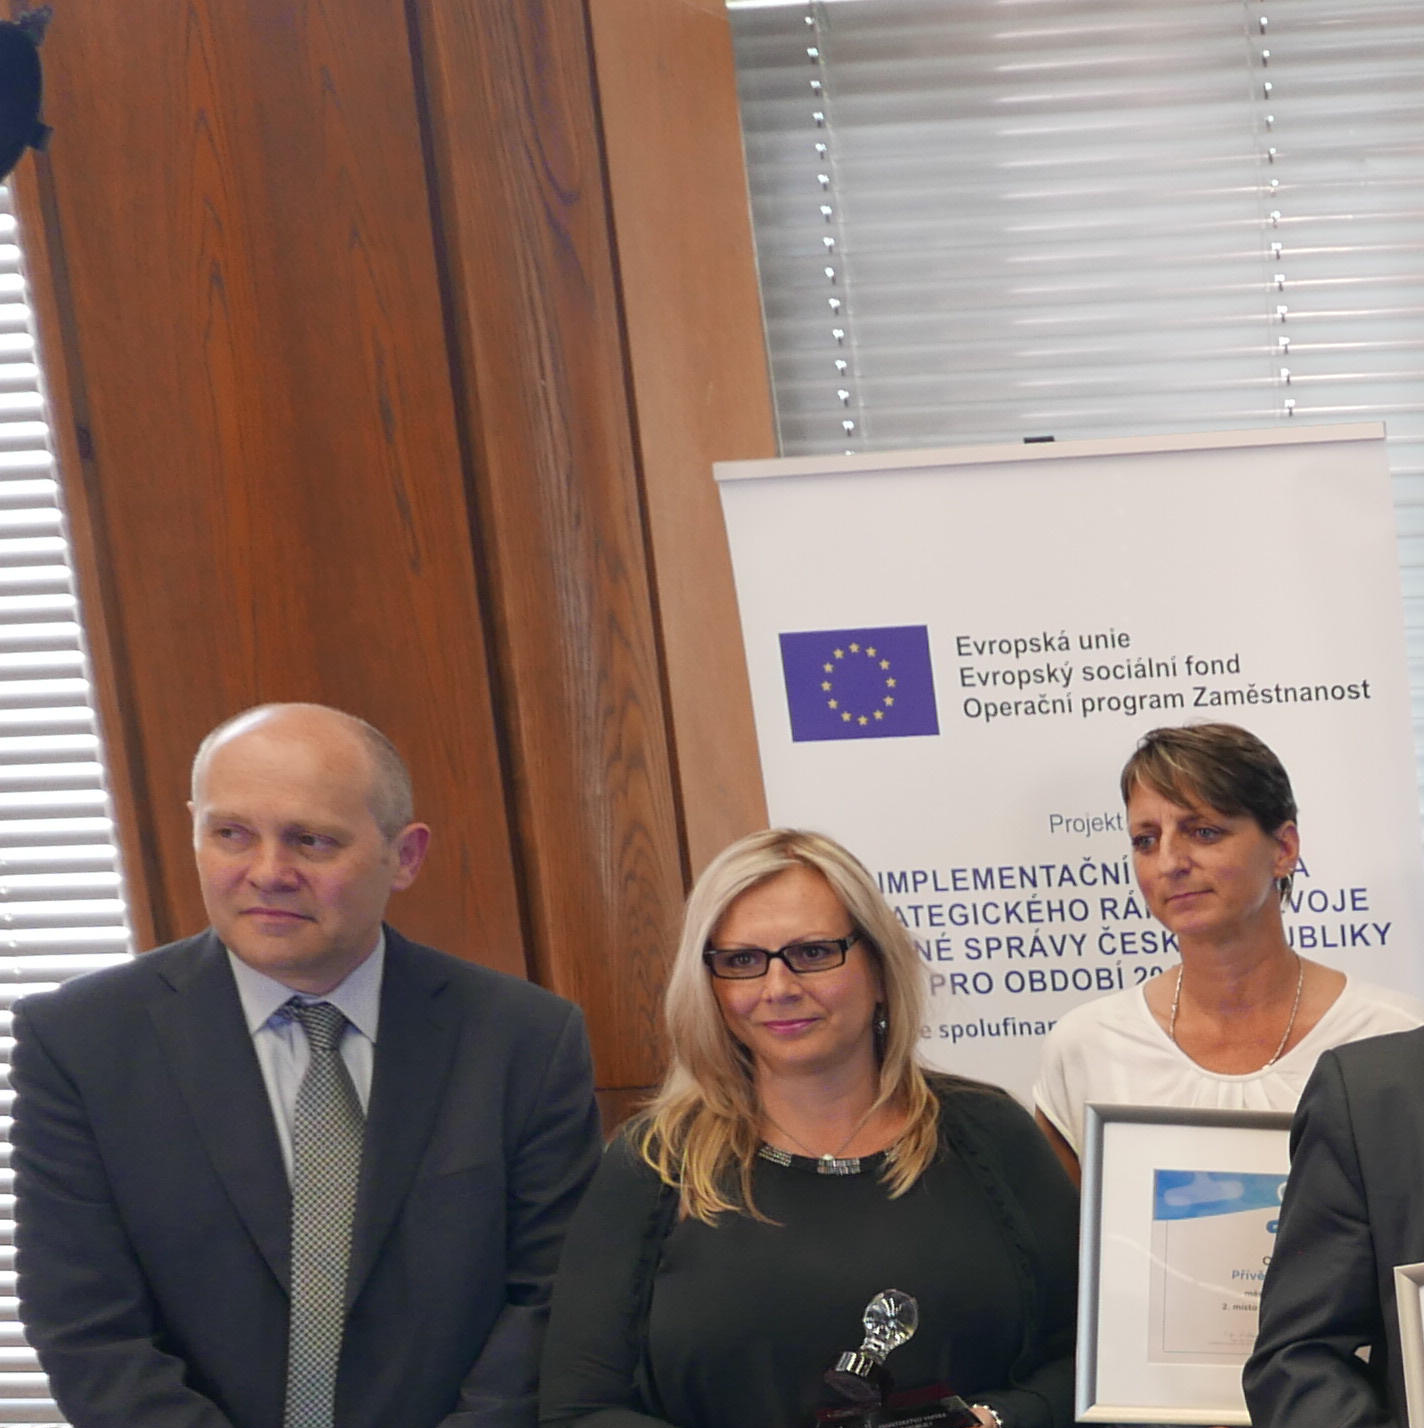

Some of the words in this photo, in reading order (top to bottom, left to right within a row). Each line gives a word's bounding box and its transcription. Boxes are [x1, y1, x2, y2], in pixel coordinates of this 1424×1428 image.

[956, 629, 1070, 659] Evropská
[1079, 627, 1131, 650] unie
[959, 661, 1073, 690] Evropský
[1082, 655, 1177, 682] sociální
[1185, 653, 1240, 676] fond
[963, 692, 1072, 723] Operační
[1081, 692, 1184, 718] program
[1193, 679, 1371, 707] Zaměstnanost
[1049, 812, 1123, 837] Projekt
[878, 854, 1131, 894] IMPLEMENTAČNÍ
[1282, 888, 1369, 914] VOJE
[964, 928, 1087, 961] SPRÁVY
[1099, 926, 1181, 956] ČESK
[930, 971, 994, 996] PRO
[1005, 960, 1124, 993] OBDOBÍ
